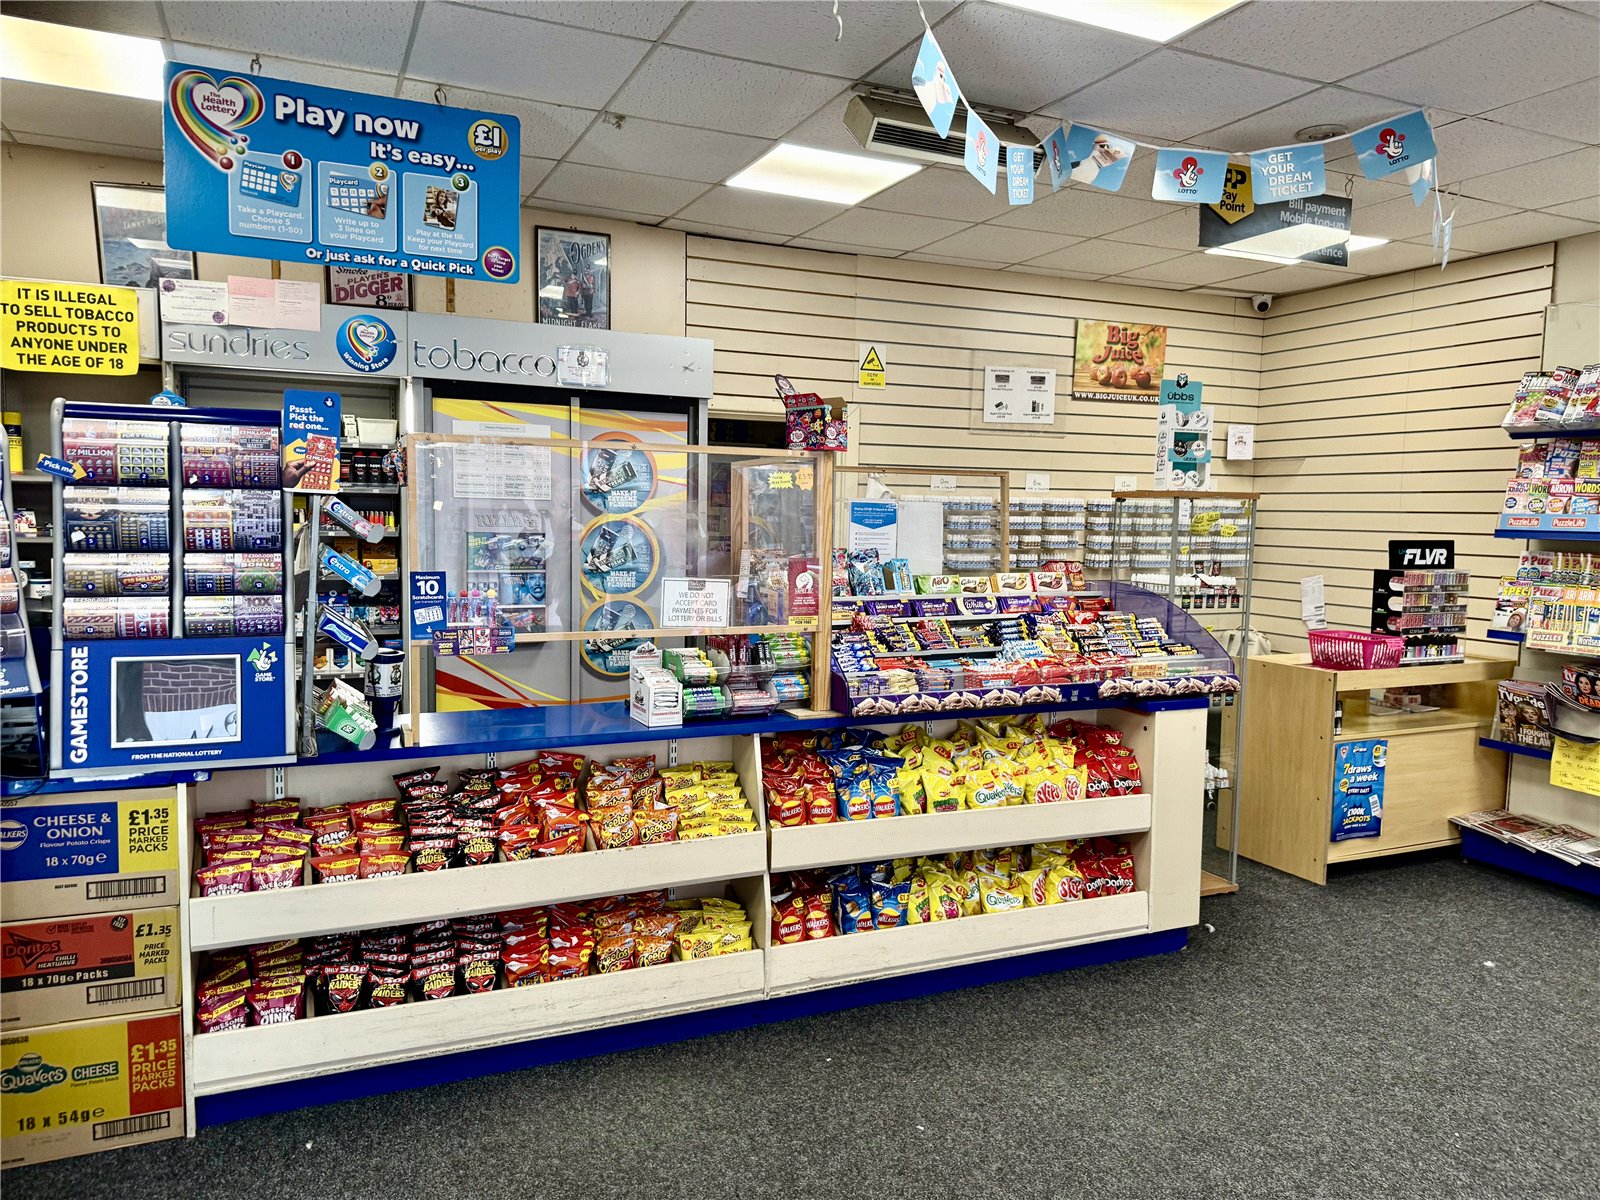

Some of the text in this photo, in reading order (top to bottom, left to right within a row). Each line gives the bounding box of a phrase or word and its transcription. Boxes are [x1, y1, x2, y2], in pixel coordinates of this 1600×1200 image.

[203, 94, 236, 108] Health
[201, 102, 237, 117] Lottery
[275, 94, 419, 140] Play now
[475, 125, 500, 147] £1
[370, 141, 475, 172] It's easy...
[1013, 152, 1024, 162] GET
[1268, 152, 1293, 164] GET
[1389, 155, 1409, 166] LOTTO
[1011, 164, 1024, 174] YOUR
[1261, 163, 1294, 176] YOUR
[1013, 177, 1028, 186] DREAM
[1269, 171, 1312, 186] DREAM
[1013, 189, 1028, 199] TICKET
[1222, 189, 1238, 202] Pay
[1270, 182, 1313, 197] TICKET
[237, 205, 257, 214] Take
[266, 208, 304, 219] Playcard.
[1220, 200, 1245, 213] Point
[1289, 199, 1346, 217] Bill payment
[252, 215, 283, 225] Choose
[334, 217, 357, 225] Write
[359, 220, 369, 228] up
[1280, 211, 1345, 230] Mobile top-up
[239, 222, 303, 236] numbers (1-50)
[345, 225, 364, 234] lines
[416, 229, 430, 237] Play
[443, 231, 453, 239] the
[330, 232, 384, 244] your Playcard
[407, 236, 474, 249] Keep your Playcard
[430, 245, 446, 253] next
[448, 247, 463, 255] time
[305, 247, 323, 259] Or
[325, 249, 351, 263] just
[353, 253, 376, 265] ask
[378, 256, 398, 267] for
[400, 260, 408, 268] a
[411, 258, 447, 272] Quick
[449, 262, 474, 275] Pick
[335, 266, 368, 276] Smoke
[347, 272, 390, 286] PLAYER'S
[17, 288, 117, 306] IT IS ILLEGAL
[0, 303, 134, 322] TO SELL TOBACCO
[16, 321, 121, 338] PRODUCTS TO
[542, 318, 577, 329] MIDNIGHT
[168, 328, 310, 360] sundries
[1107, 325, 1140, 350] Big
[10, 337, 128, 354] ANYONE UNDER
[16, 353, 124, 370] THE AGE OF 18
[413, 338, 556, 377] tobacco
[1092, 345, 1144, 365] Juice
[343, 352, 389, 372] Winning Store
[1075, 391, 1160, 403] WWW.BIGJUICEUK.CO.UK
[289, 405, 316, 414] Pssst.
[289, 413, 324, 422] Pick the
[289, 421, 304, 429] red
[44, 460, 74, 474] Pick me
[333, 504, 353, 520] extra
[1508, 518, 1539, 527] PuzzleLife
[1403, 549, 1447, 565] FLVR
[416, 580, 439, 595] 10
[1532, 634, 1562, 642] PUZZLES
[70, 646, 89, 763] GAMESTORE
[1518, 733, 1533, 744] THE
[1523, 728, 1550, 738] FOUGHT
[1356, 772, 1379, 782] week
[1114, 779, 1141, 790] Doritos
[129, 808, 169, 826] £1.35
[781, 807, 801, 817] WALKERS
[33, 813, 112, 827] CHEESE &
[1343, 815, 1371, 825] JACKPOTS
[47, 826, 103, 839] ONION
[129, 826, 169, 837] PRICE
[317, 831, 350, 844] TANGY
[640, 820, 672, 842] Cheetos
[90, 838, 111, 846] Crisps
[129, 836, 168, 845] MARKED
[129, 842, 168, 853] PACKS
[416, 854, 447, 865] RAIDERS
[207, 883, 244, 893] AWESOME
[987, 893, 1021, 906] Quavers
[135, 924, 171, 937] £1.35
[3, 940, 60, 957] Doritos
[144, 942, 165, 950] PRICE
[55, 954, 76, 962] CHILLI
[139, 949, 169, 958] MARKED
[38, 959, 76, 969] HEATWAVE
[144, 956, 167, 965] PACKS
[260, 1013, 295, 1025] OINKS
[131, 1039, 177, 1062] £1.35
[74, 1063, 117, 1079] CHEESE
[132, 1058, 176, 1075] PRICE
[1, 1068, 64, 1088] Quavers
[132, 1070, 176, 1083] MARKED
[132, 1078, 176, 1093] PACKS
